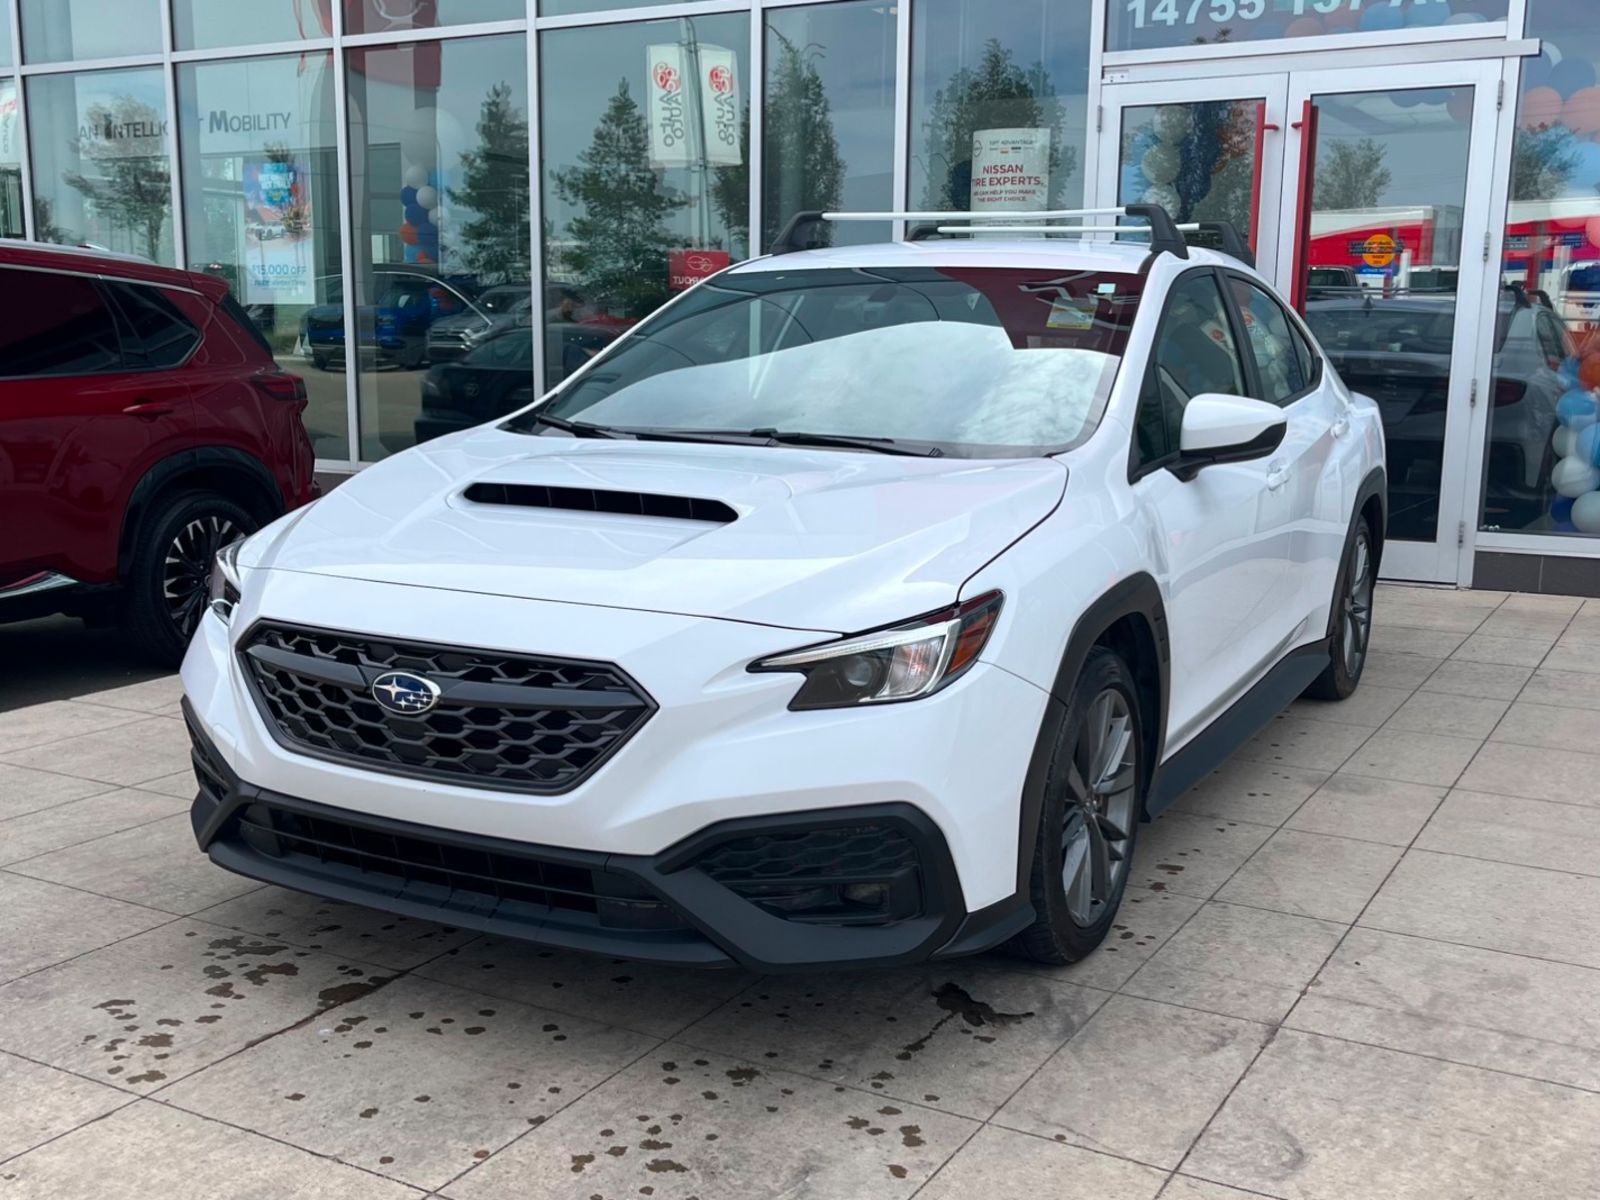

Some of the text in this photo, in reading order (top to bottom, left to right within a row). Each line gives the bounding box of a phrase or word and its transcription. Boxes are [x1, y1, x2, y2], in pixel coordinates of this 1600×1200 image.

[1127, 0, 1266, 28] 14755
[209, 110, 291, 134] MOBILITY
[982, 164, 1024, 175] NISSAN
